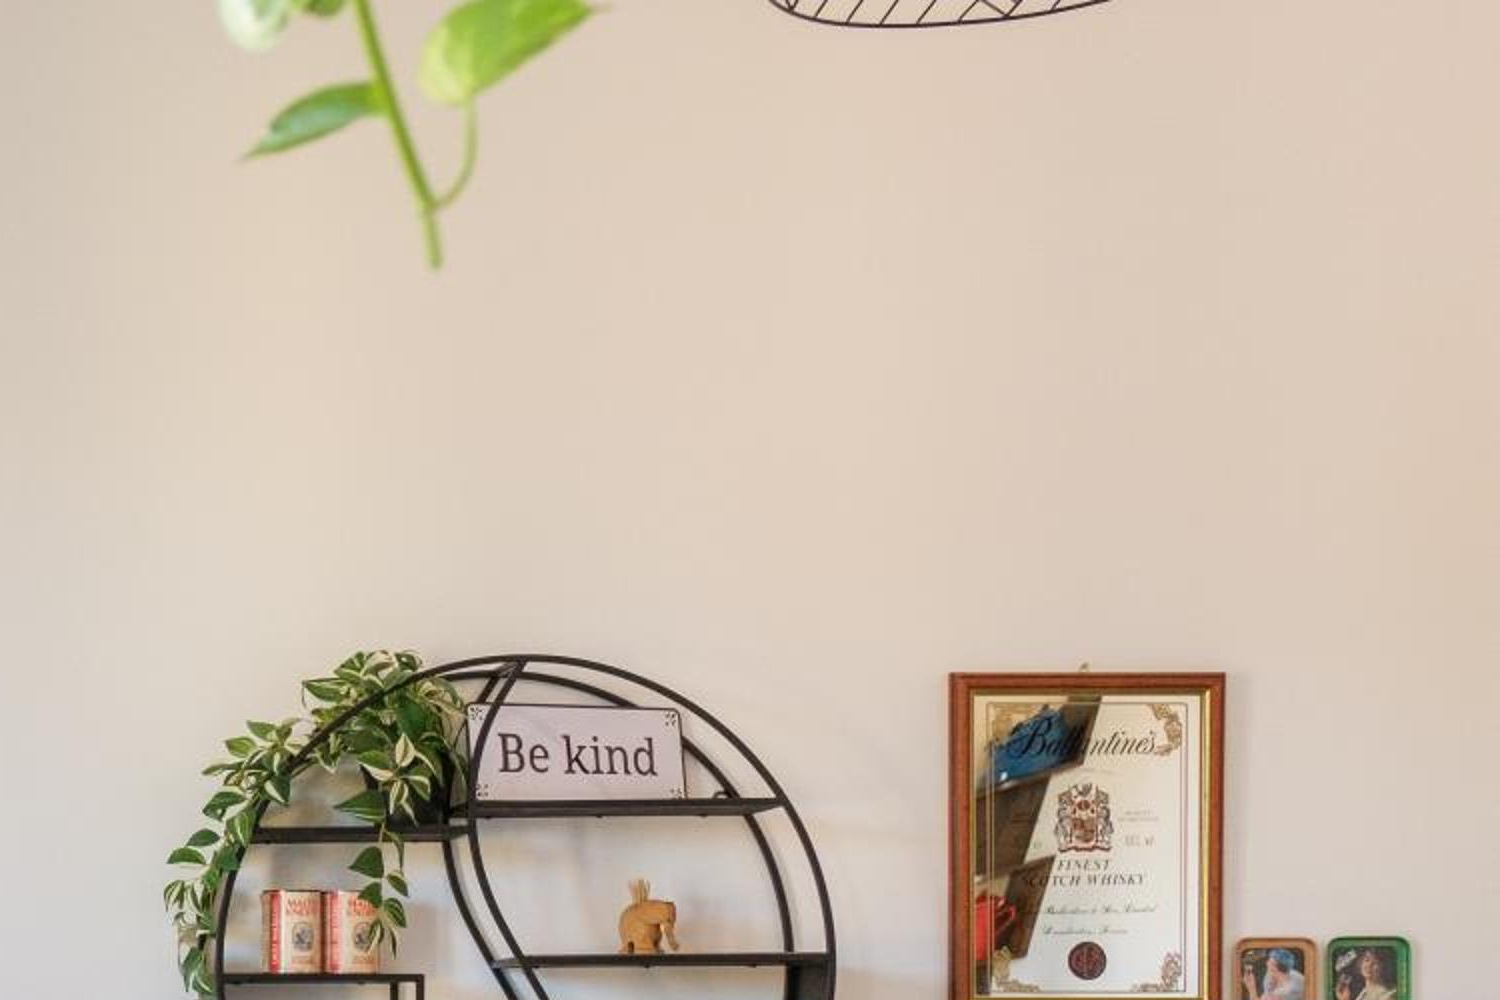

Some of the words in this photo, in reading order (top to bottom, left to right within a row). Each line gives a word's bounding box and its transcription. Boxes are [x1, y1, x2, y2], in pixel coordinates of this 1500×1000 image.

[497, 733, 549, 773] Be
[561, 735, 658, 776] kind
[1057, 859, 1111, 871] FINEST
[1088, 873, 1145, 885] WHISKY
